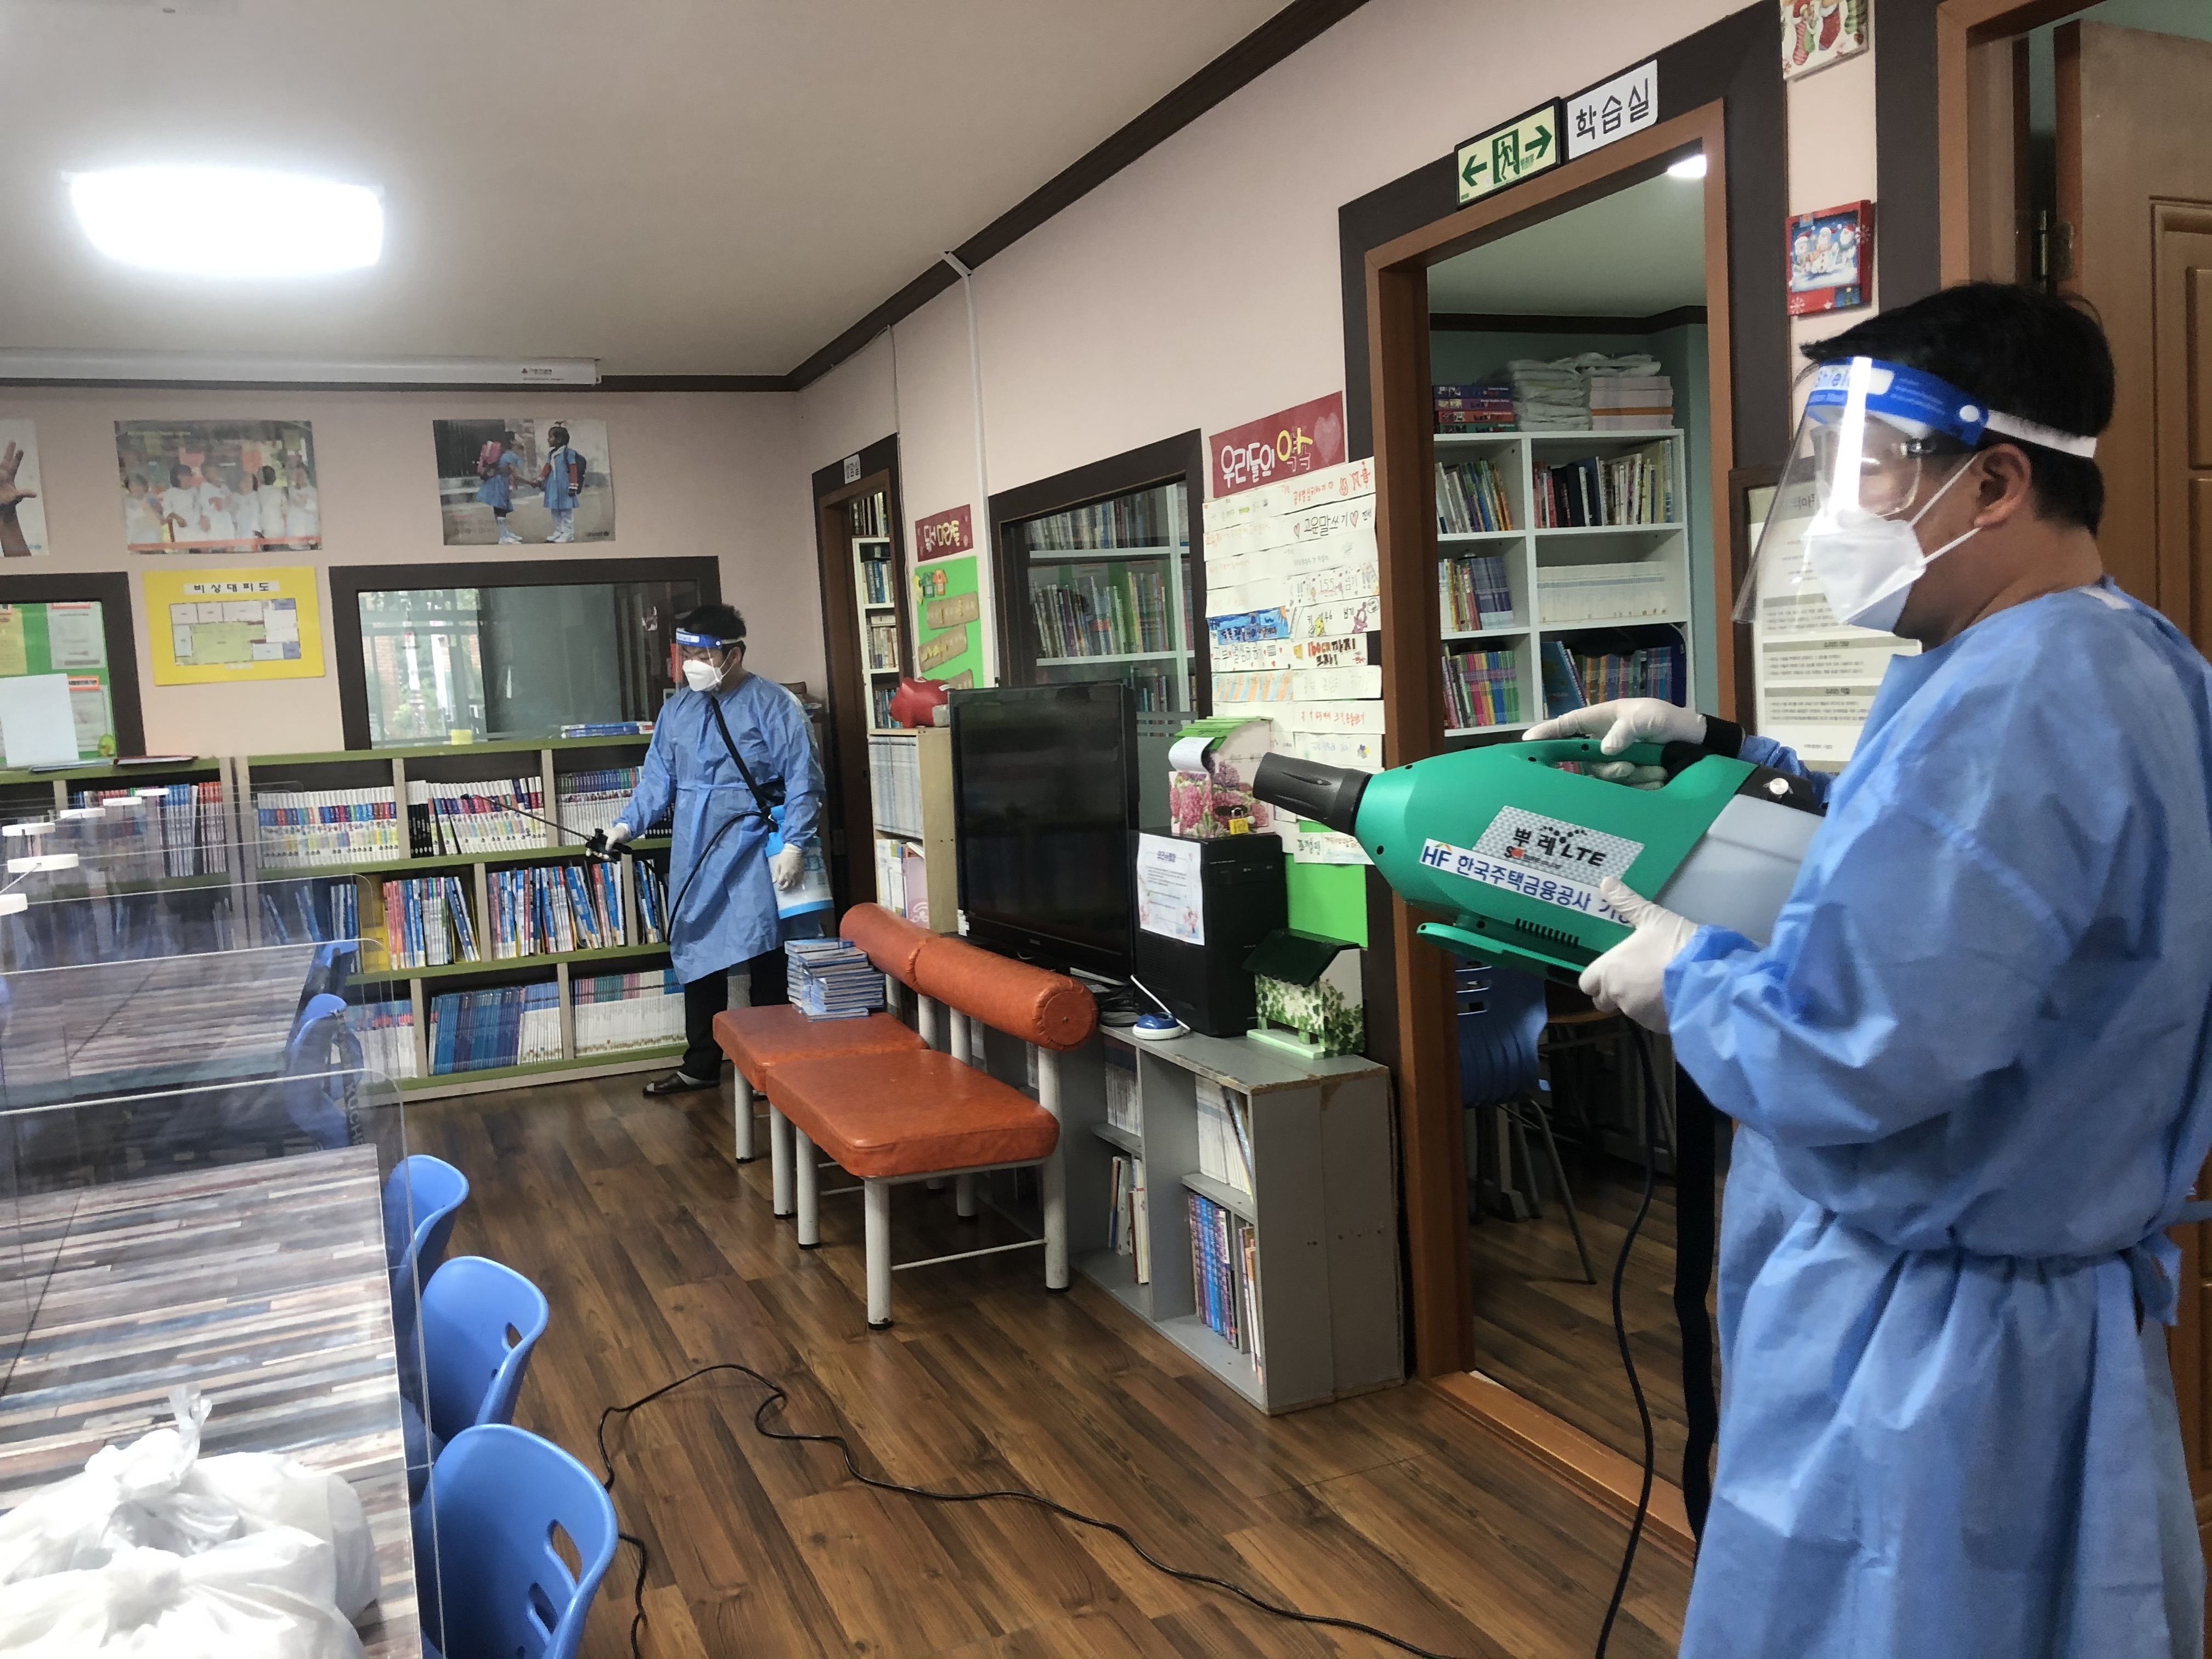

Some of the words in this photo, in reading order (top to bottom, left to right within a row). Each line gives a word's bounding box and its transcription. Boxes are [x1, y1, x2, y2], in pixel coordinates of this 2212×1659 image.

[1576, 77, 1651, 140] 학습실
[1221, 442, 1276, 489] 우리들의
[193, 582, 270, 594] 비상대피도
[1421, 845, 1452, 870] HF
[1458, 854, 1592, 911] 한국주택금융공사
[1560, 843, 1606, 867] LTE
